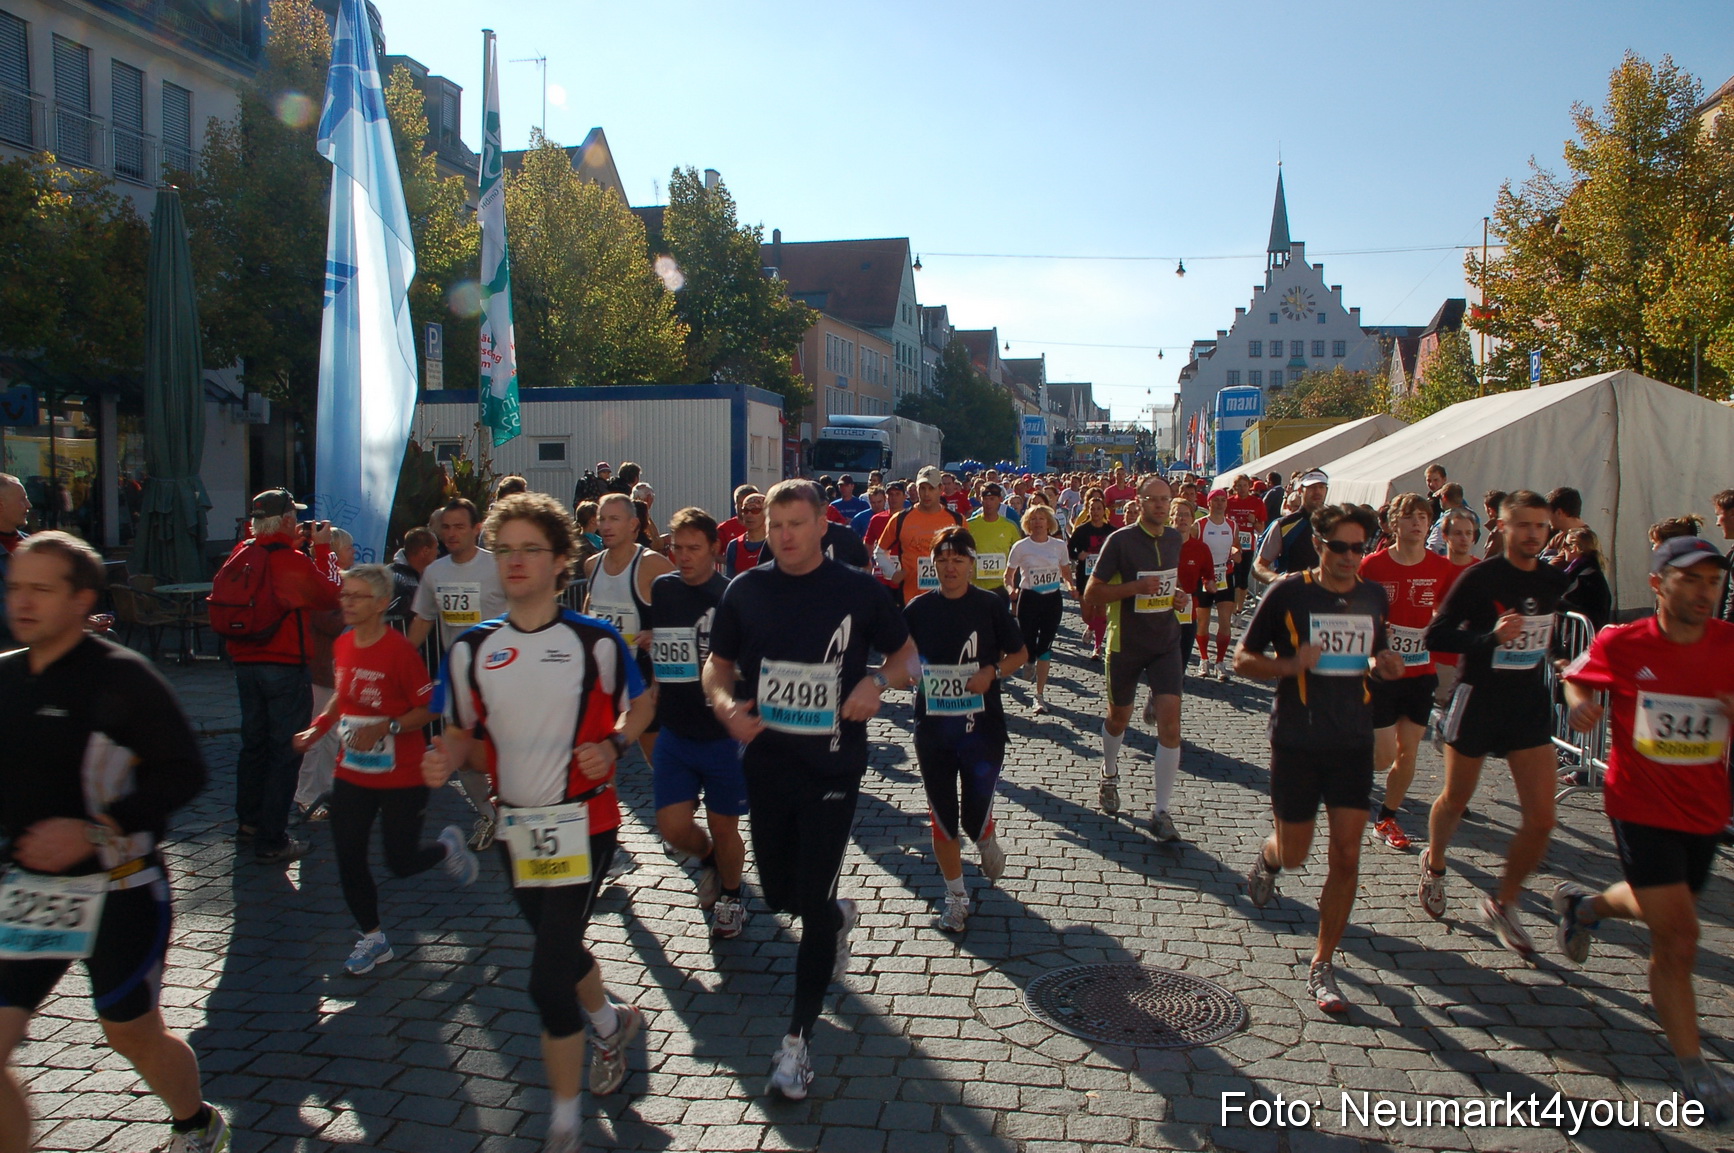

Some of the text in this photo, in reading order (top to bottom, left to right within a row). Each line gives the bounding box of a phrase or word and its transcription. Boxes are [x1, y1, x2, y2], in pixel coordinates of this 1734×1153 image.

[1226, 394, 1258, 411] maxi
[921, 565, 936, 577] 25
[982, 560, 1000, 570] 521
[920, 578, 939, 586] Alexa
[1032, 572, 1058, 586] 3467
[443, 594, 469, 610] 873
[1319, 631, 1365, 653] 3571
[653, 642, 690, 662] 2968
[767, 678, 828, 709] 2498
[930, 678, 970, 697] 228
[936, 698, 973, 709] Monika
[772, 707, 820, 724] Markus
[1656, 713, 1712, 740] 344
